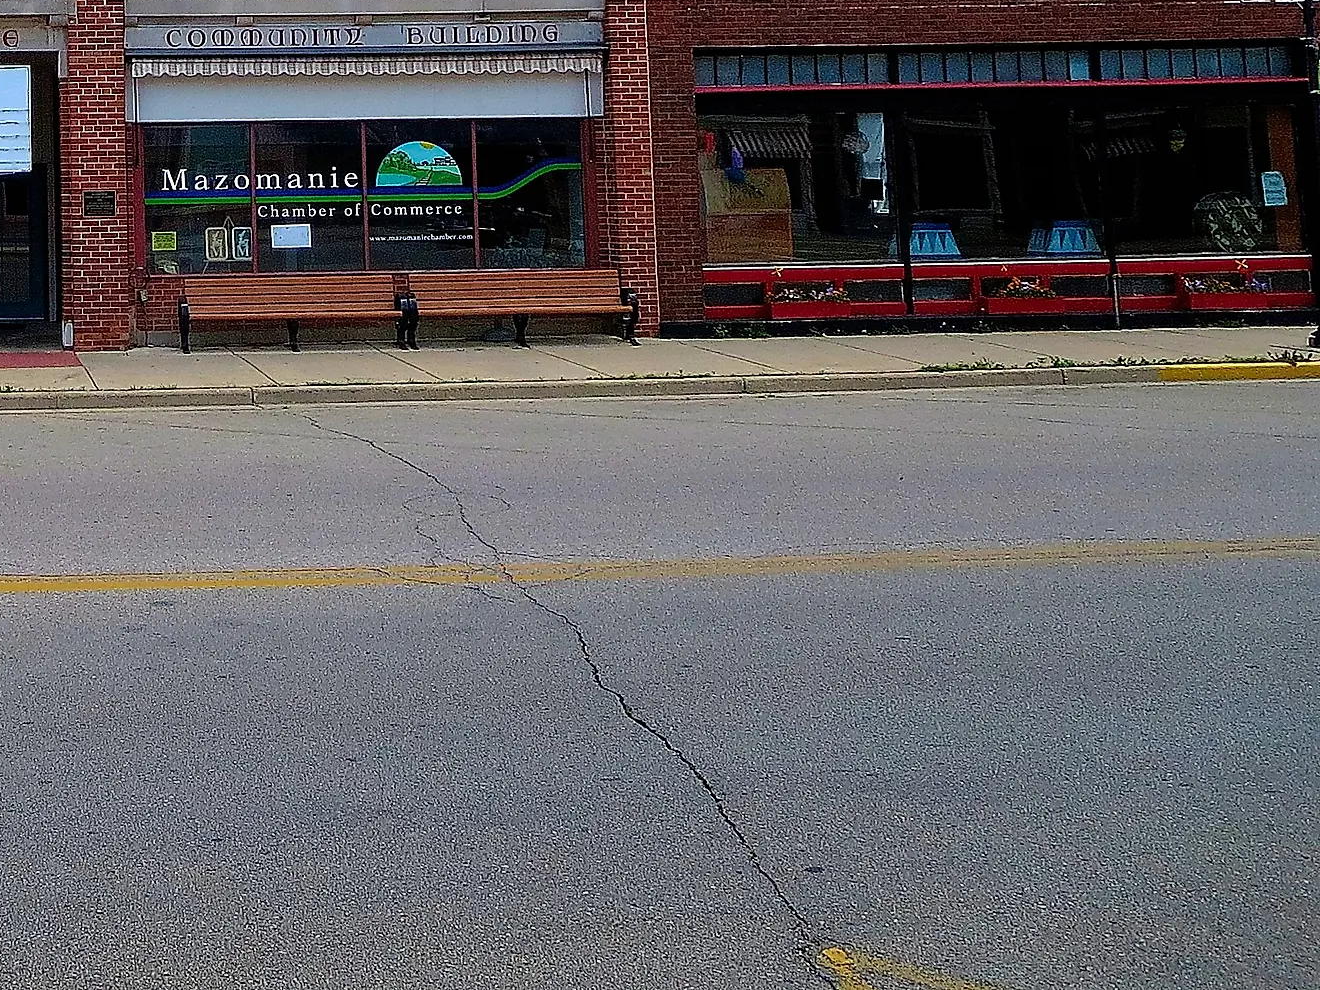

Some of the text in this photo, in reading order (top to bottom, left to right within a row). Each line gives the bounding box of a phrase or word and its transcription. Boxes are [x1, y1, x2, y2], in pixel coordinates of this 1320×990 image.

[166, 25, 558, 47] COMMUNITY BUILDING
[161, 166, 359, 191] Mazomanie
[257, 203, 462, 218] Chamber of Commerce
